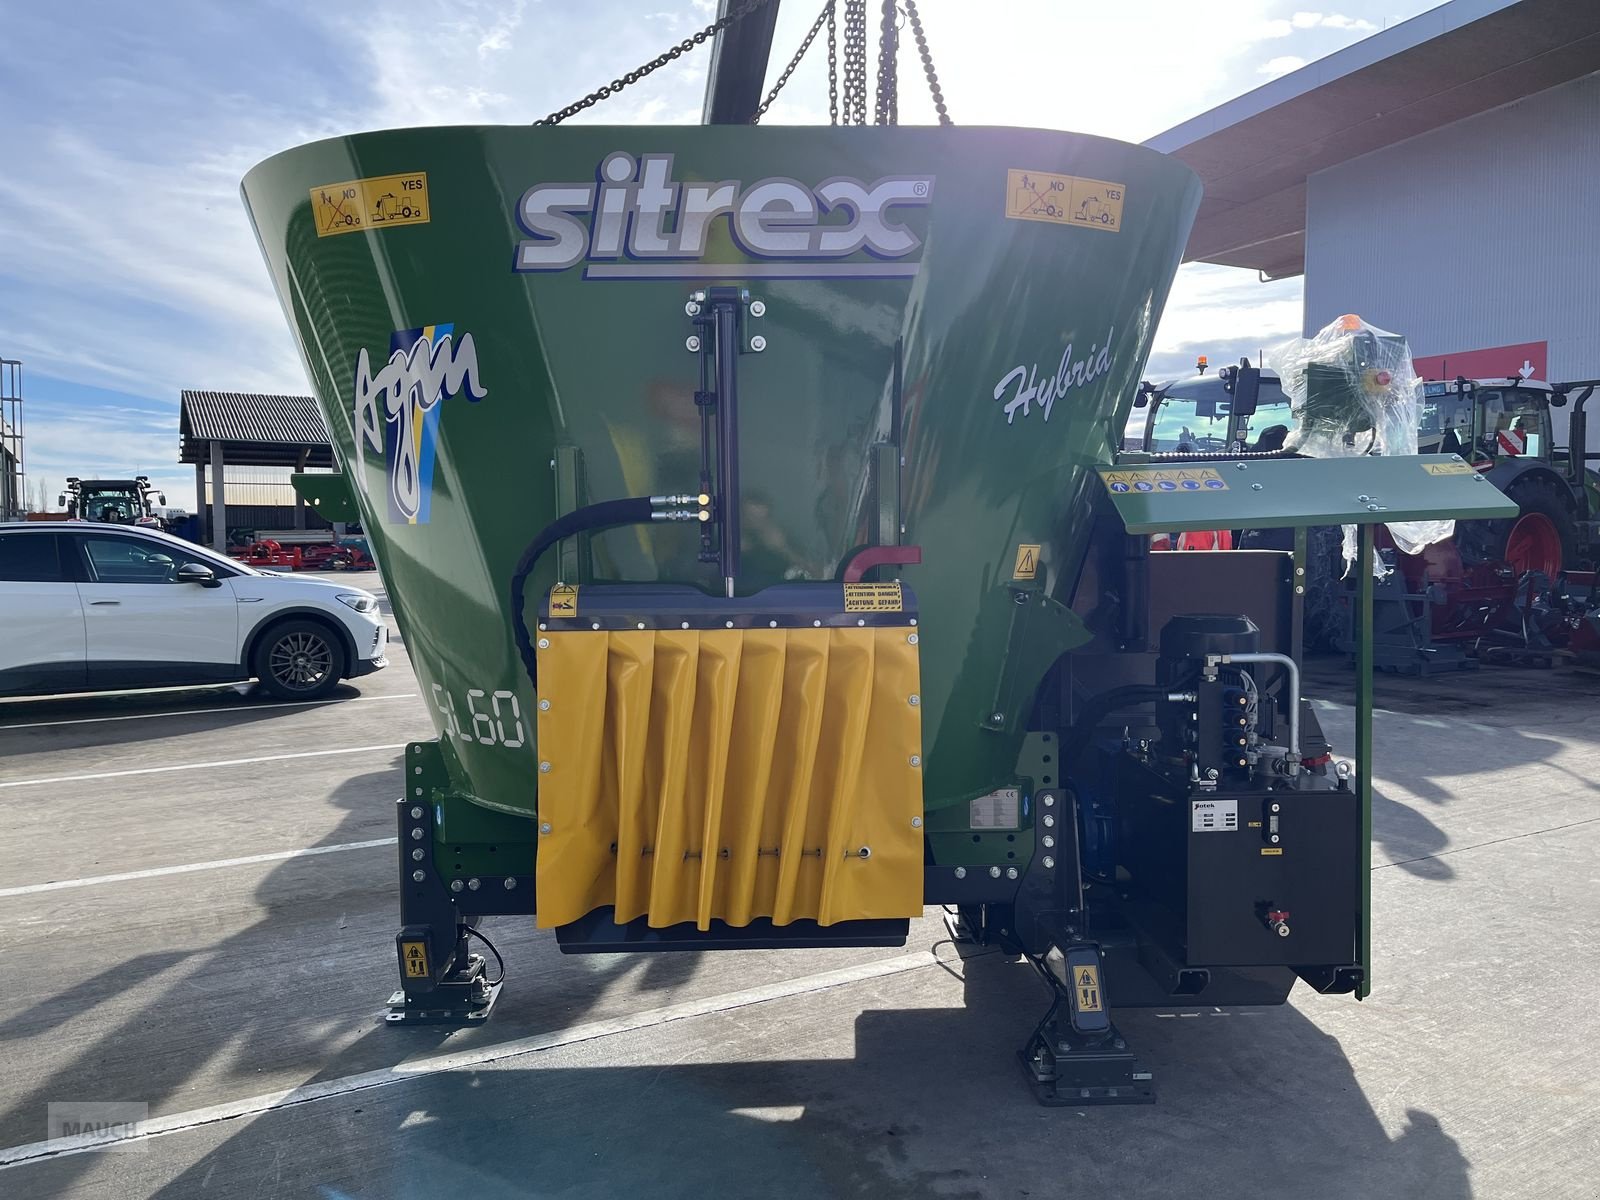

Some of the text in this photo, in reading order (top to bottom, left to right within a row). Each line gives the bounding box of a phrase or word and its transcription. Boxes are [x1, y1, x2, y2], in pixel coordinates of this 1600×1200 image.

[401, 179, 423, 191] YES
[1050, 181, 1065, 192] NO
[342, 188, 356, 200] NO
[1105, 189, 1121, 201] YES
[993, 325, 1113, 424] Hybrid
